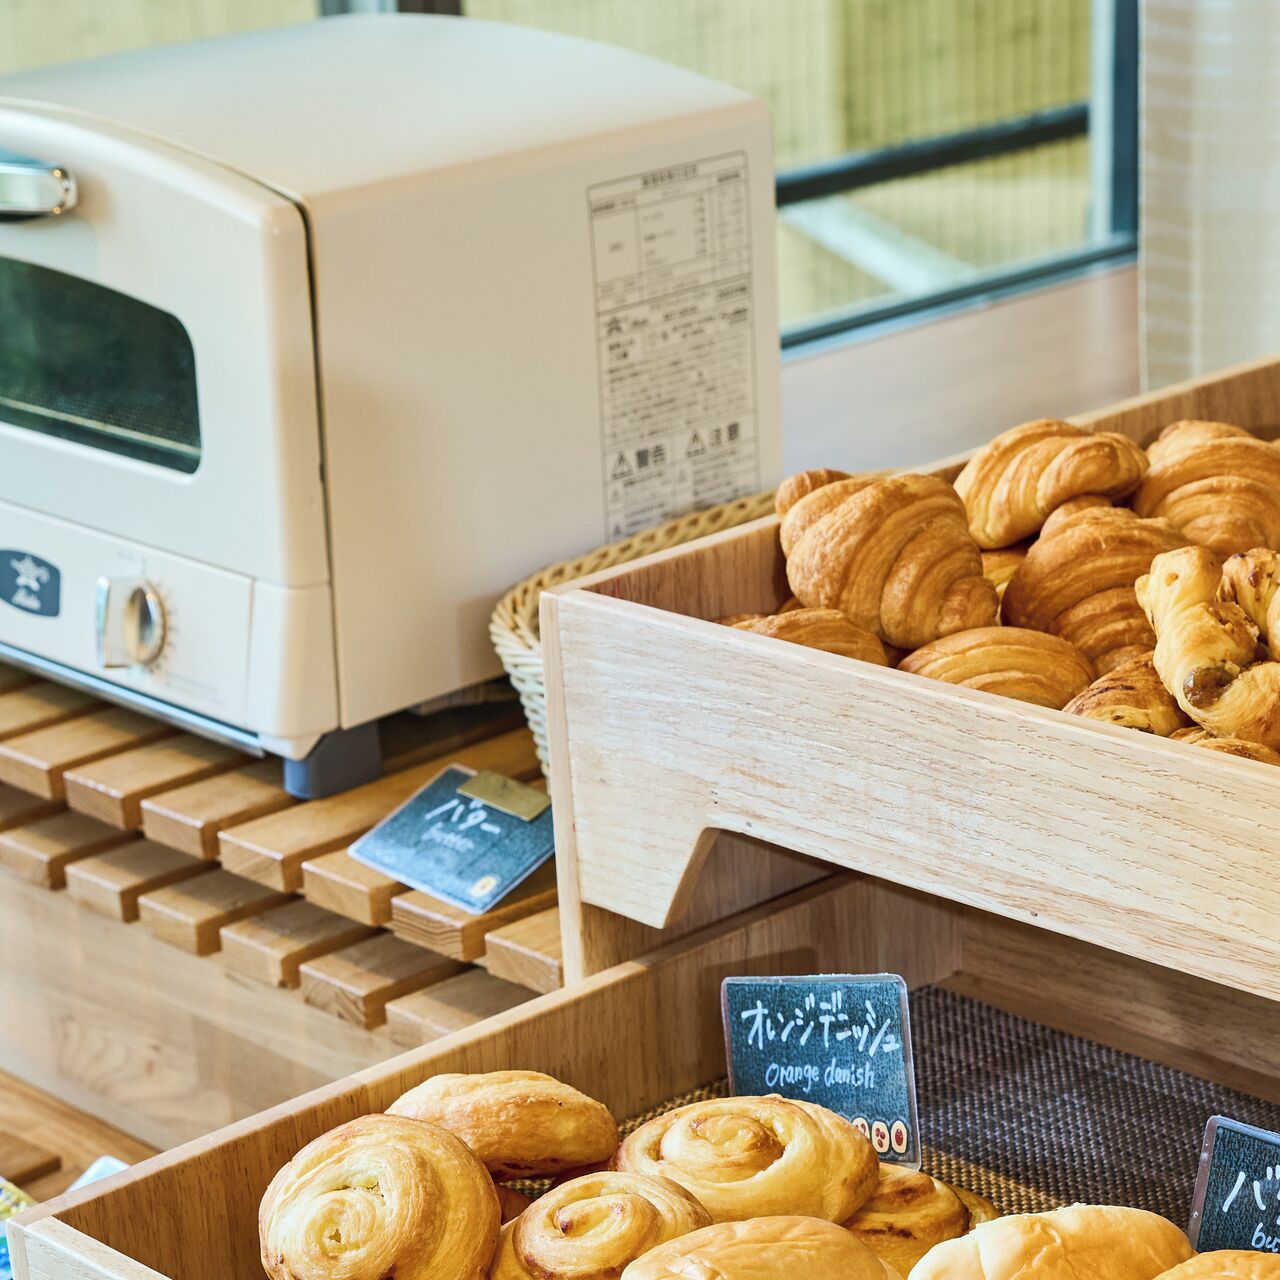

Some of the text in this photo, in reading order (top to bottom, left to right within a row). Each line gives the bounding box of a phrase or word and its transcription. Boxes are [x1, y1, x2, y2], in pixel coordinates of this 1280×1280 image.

[424, 798, 501, 835] バター
[824, 1057, 875, 1090] danish
